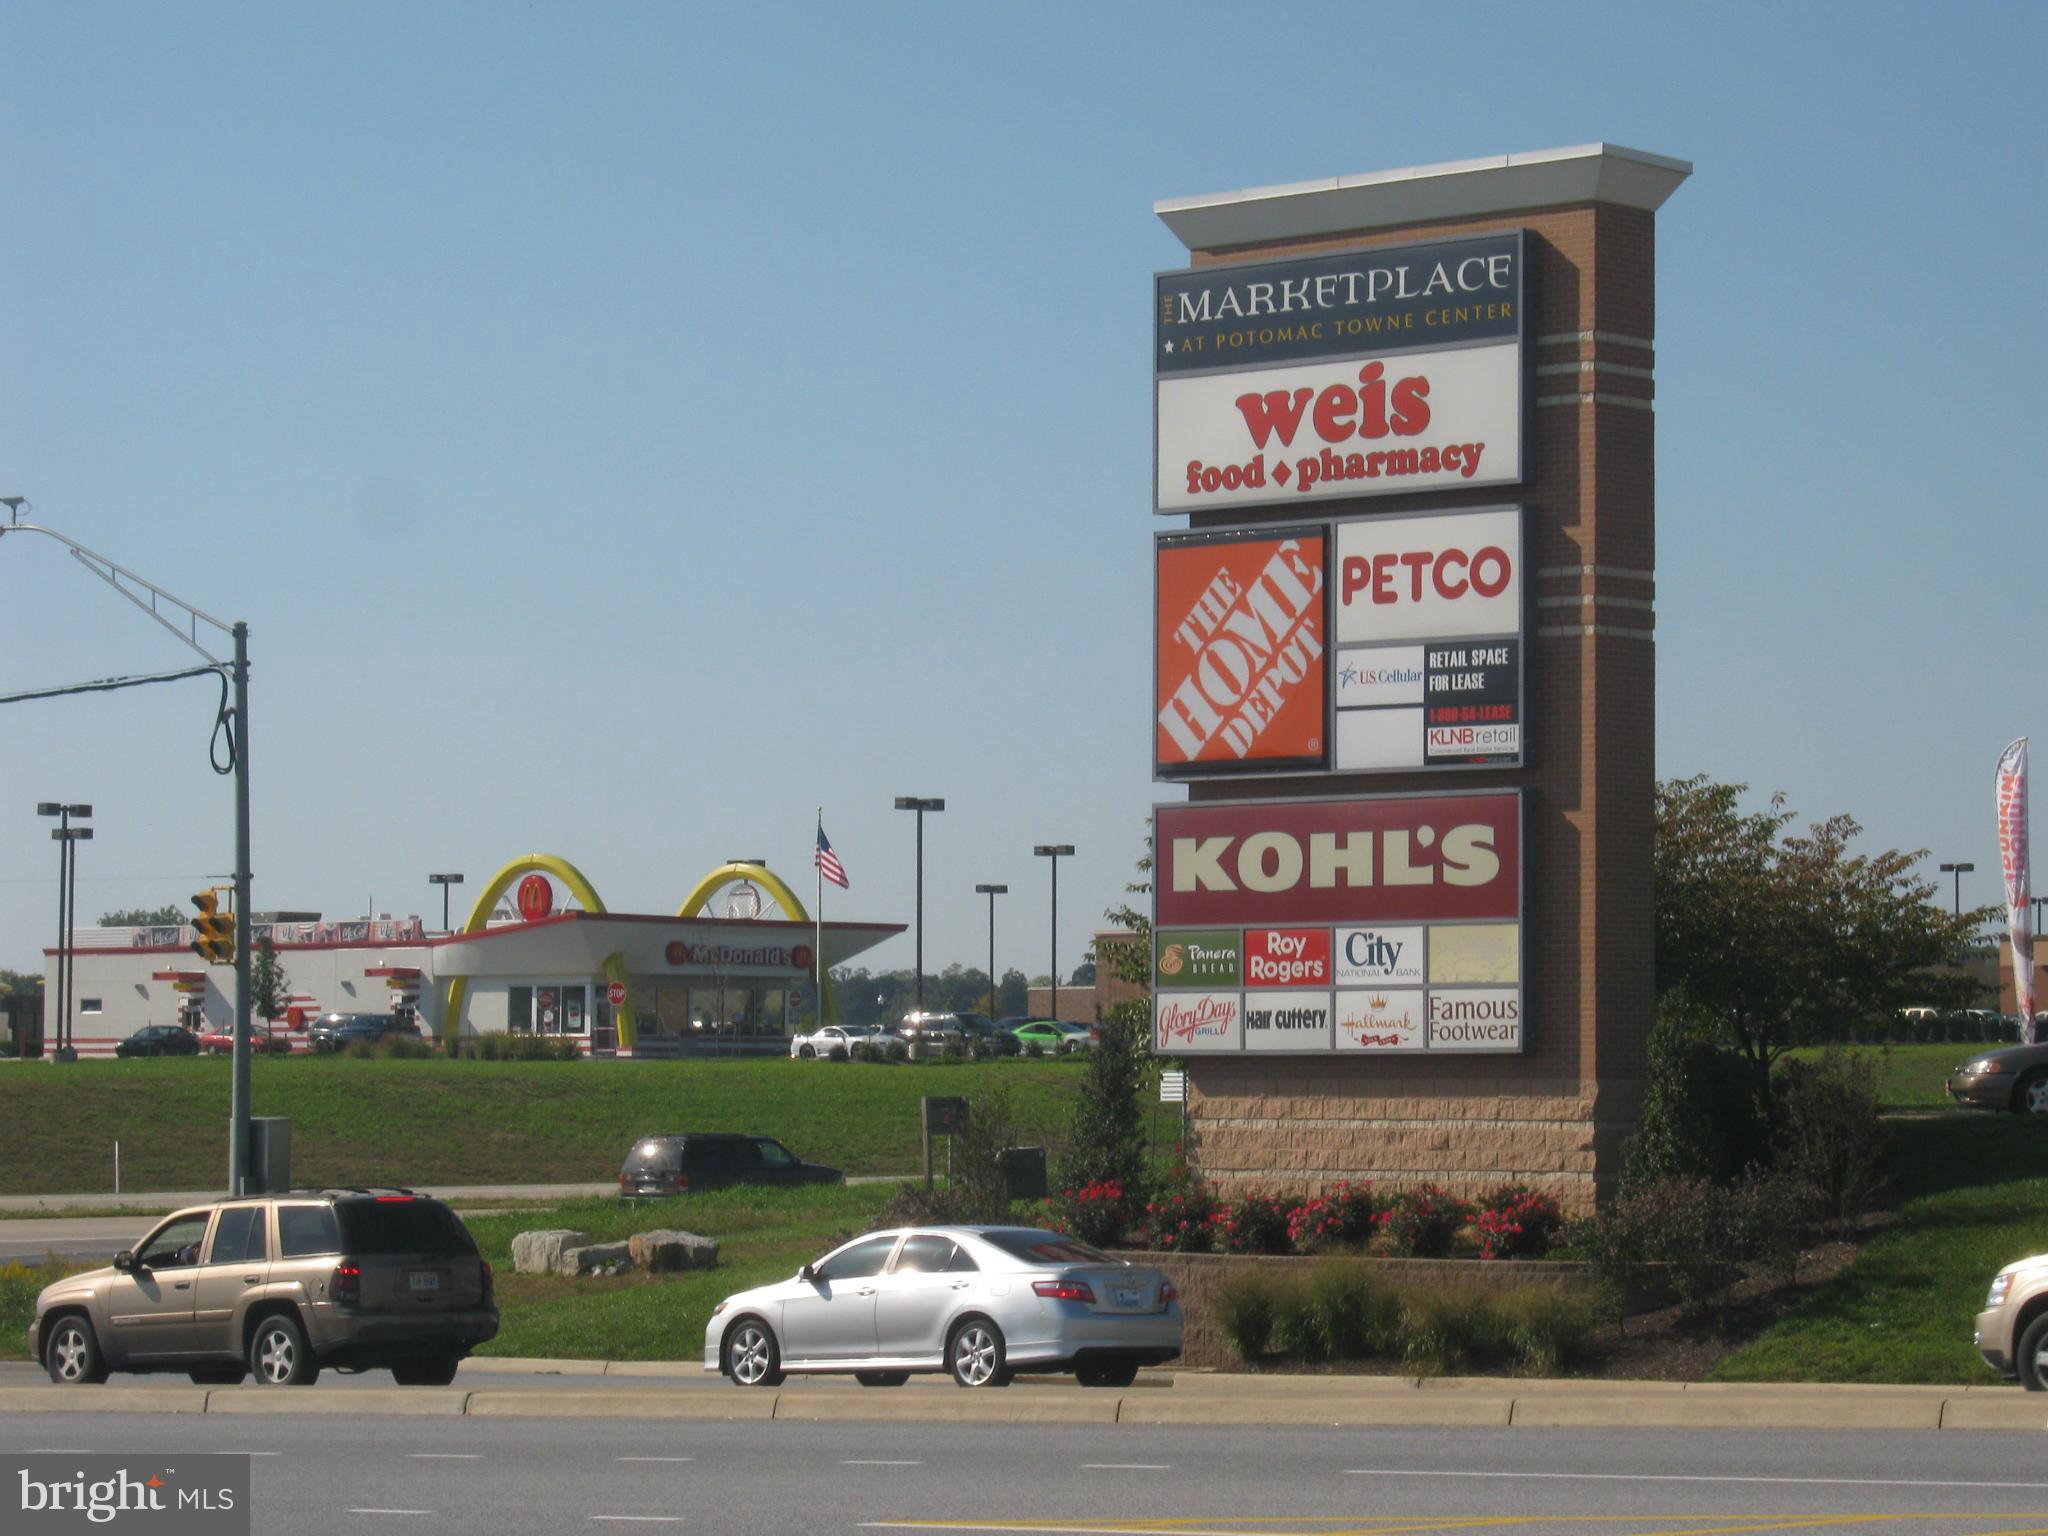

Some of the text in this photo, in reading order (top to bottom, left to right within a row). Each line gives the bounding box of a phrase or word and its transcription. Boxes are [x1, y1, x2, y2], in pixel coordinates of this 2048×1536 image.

[1176, 254, 1513, 324] MARKETPLACE
[1164, 294, 1174, 325] THE
[1181, 301, 1513, 352] AT POTOMAC TOWNE CENTER
[1235, 360, 1432, 450] weis
[1186, 442, 1486, 494] food pharmacy
[1342, 545, 1513, 606] PETCO
[1173, 566, 1243, 655] THE
[1158, 539, 1324, 762] HOME
[1429, 648, 1509, 669] RETAIL SPACE
[1220, 617, 1324, 760] DEPOT
[1378, 668, 1423, 684] Cellular
[1429, 672, 1485, 692] FOR LEASE
[1173, 823, 1500, 893] KOHL'S
[1187, 944, 1237, 961] Panera
[1267, 931, 1307, 958] Roy
[1345, 932, 1404, 976] City
[1193, 962, 1234, 975] BREAD
[1250, 955, 1324, 983] Rogers
[1336, 968, 1421, 978] NATIONAL BANK
[608, 987, 625, 998] STOP
[1159, 994, 1236, 1048] Glory Days
[1429, 996, 1518, 1021] Famous
[1194, 1026, 1221, 1037] GRILL
[1341, 1011, 1418, 1038] Hallmark
[1429, 1021, 1518, 1041] Footwear
